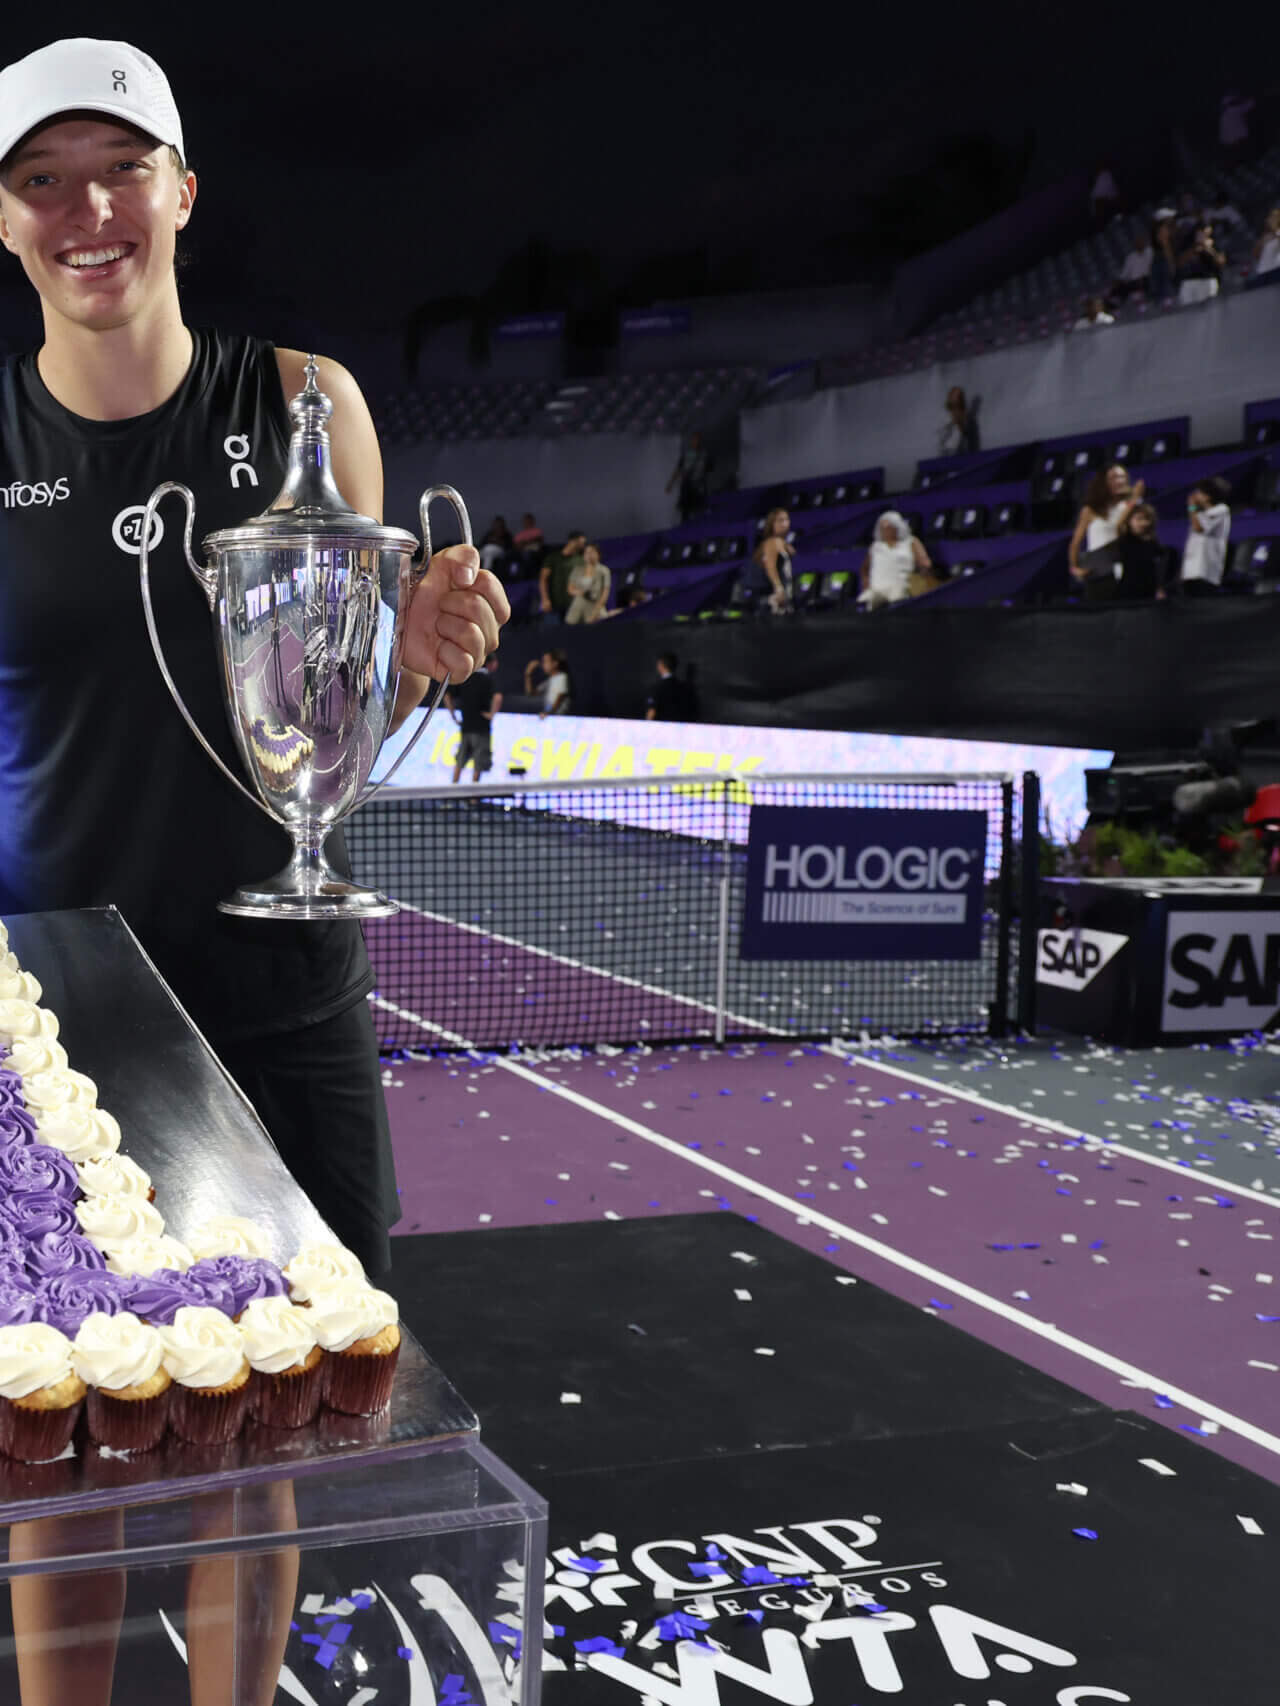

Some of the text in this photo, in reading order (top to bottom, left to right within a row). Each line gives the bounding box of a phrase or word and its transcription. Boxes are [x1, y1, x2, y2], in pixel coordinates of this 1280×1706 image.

[765, 844, 970, 890] HOLOGIC
[1041, 934, 1101, 978] SAP
[1168, 932, 1280, 1009] SA
[631, 1519, 878, 1590] GNP
[683, 1572, 948, 1619] SEGUROS
[586, 1604, 1078, 1706] WTA
